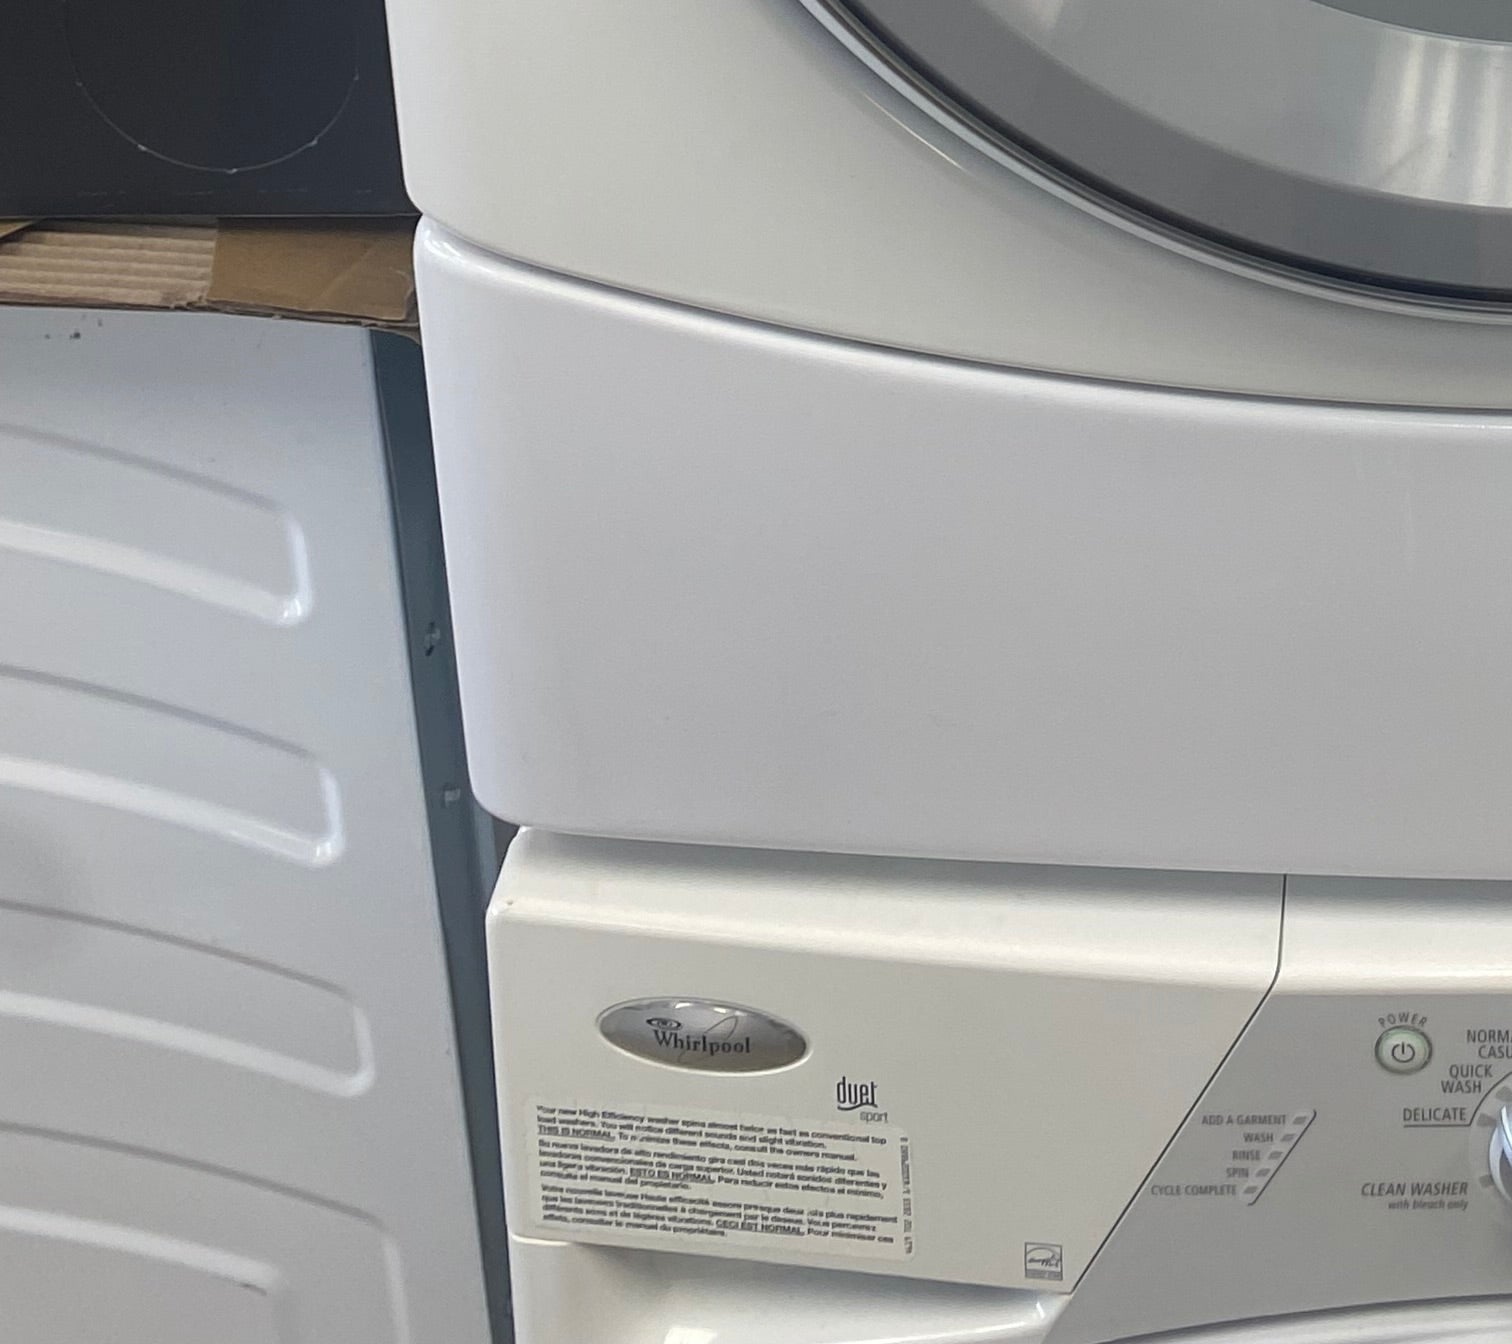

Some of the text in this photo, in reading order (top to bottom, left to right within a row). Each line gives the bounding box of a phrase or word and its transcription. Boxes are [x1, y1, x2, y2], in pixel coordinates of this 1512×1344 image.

[1378, 1013, 1428, 1028] POWER
[654, 1029, 751, 1056] Whirlpool
[1449, 1064, 1493, 1079] QUICK
[836, 1076, 878, 1112] duet
[1441, 1080, 1481, 1094] WASH
[860, 1110, 888, 1123] sport
[1202, 1115, 1286, 1125] ADD A GARMENT
[1403, 1107, 1466, 1121] DELICATE
[1243, 1133, 1273, 1142] WASH
[1232, 1150, 1260, 1160] RINSE
[1226, 1168, 1249, 1178] SPIN
[1151, 1185, 1236, 1196] CYCLE COMPLETE
[1361, 1182, 1468, 1196] CLEAN WASHER
